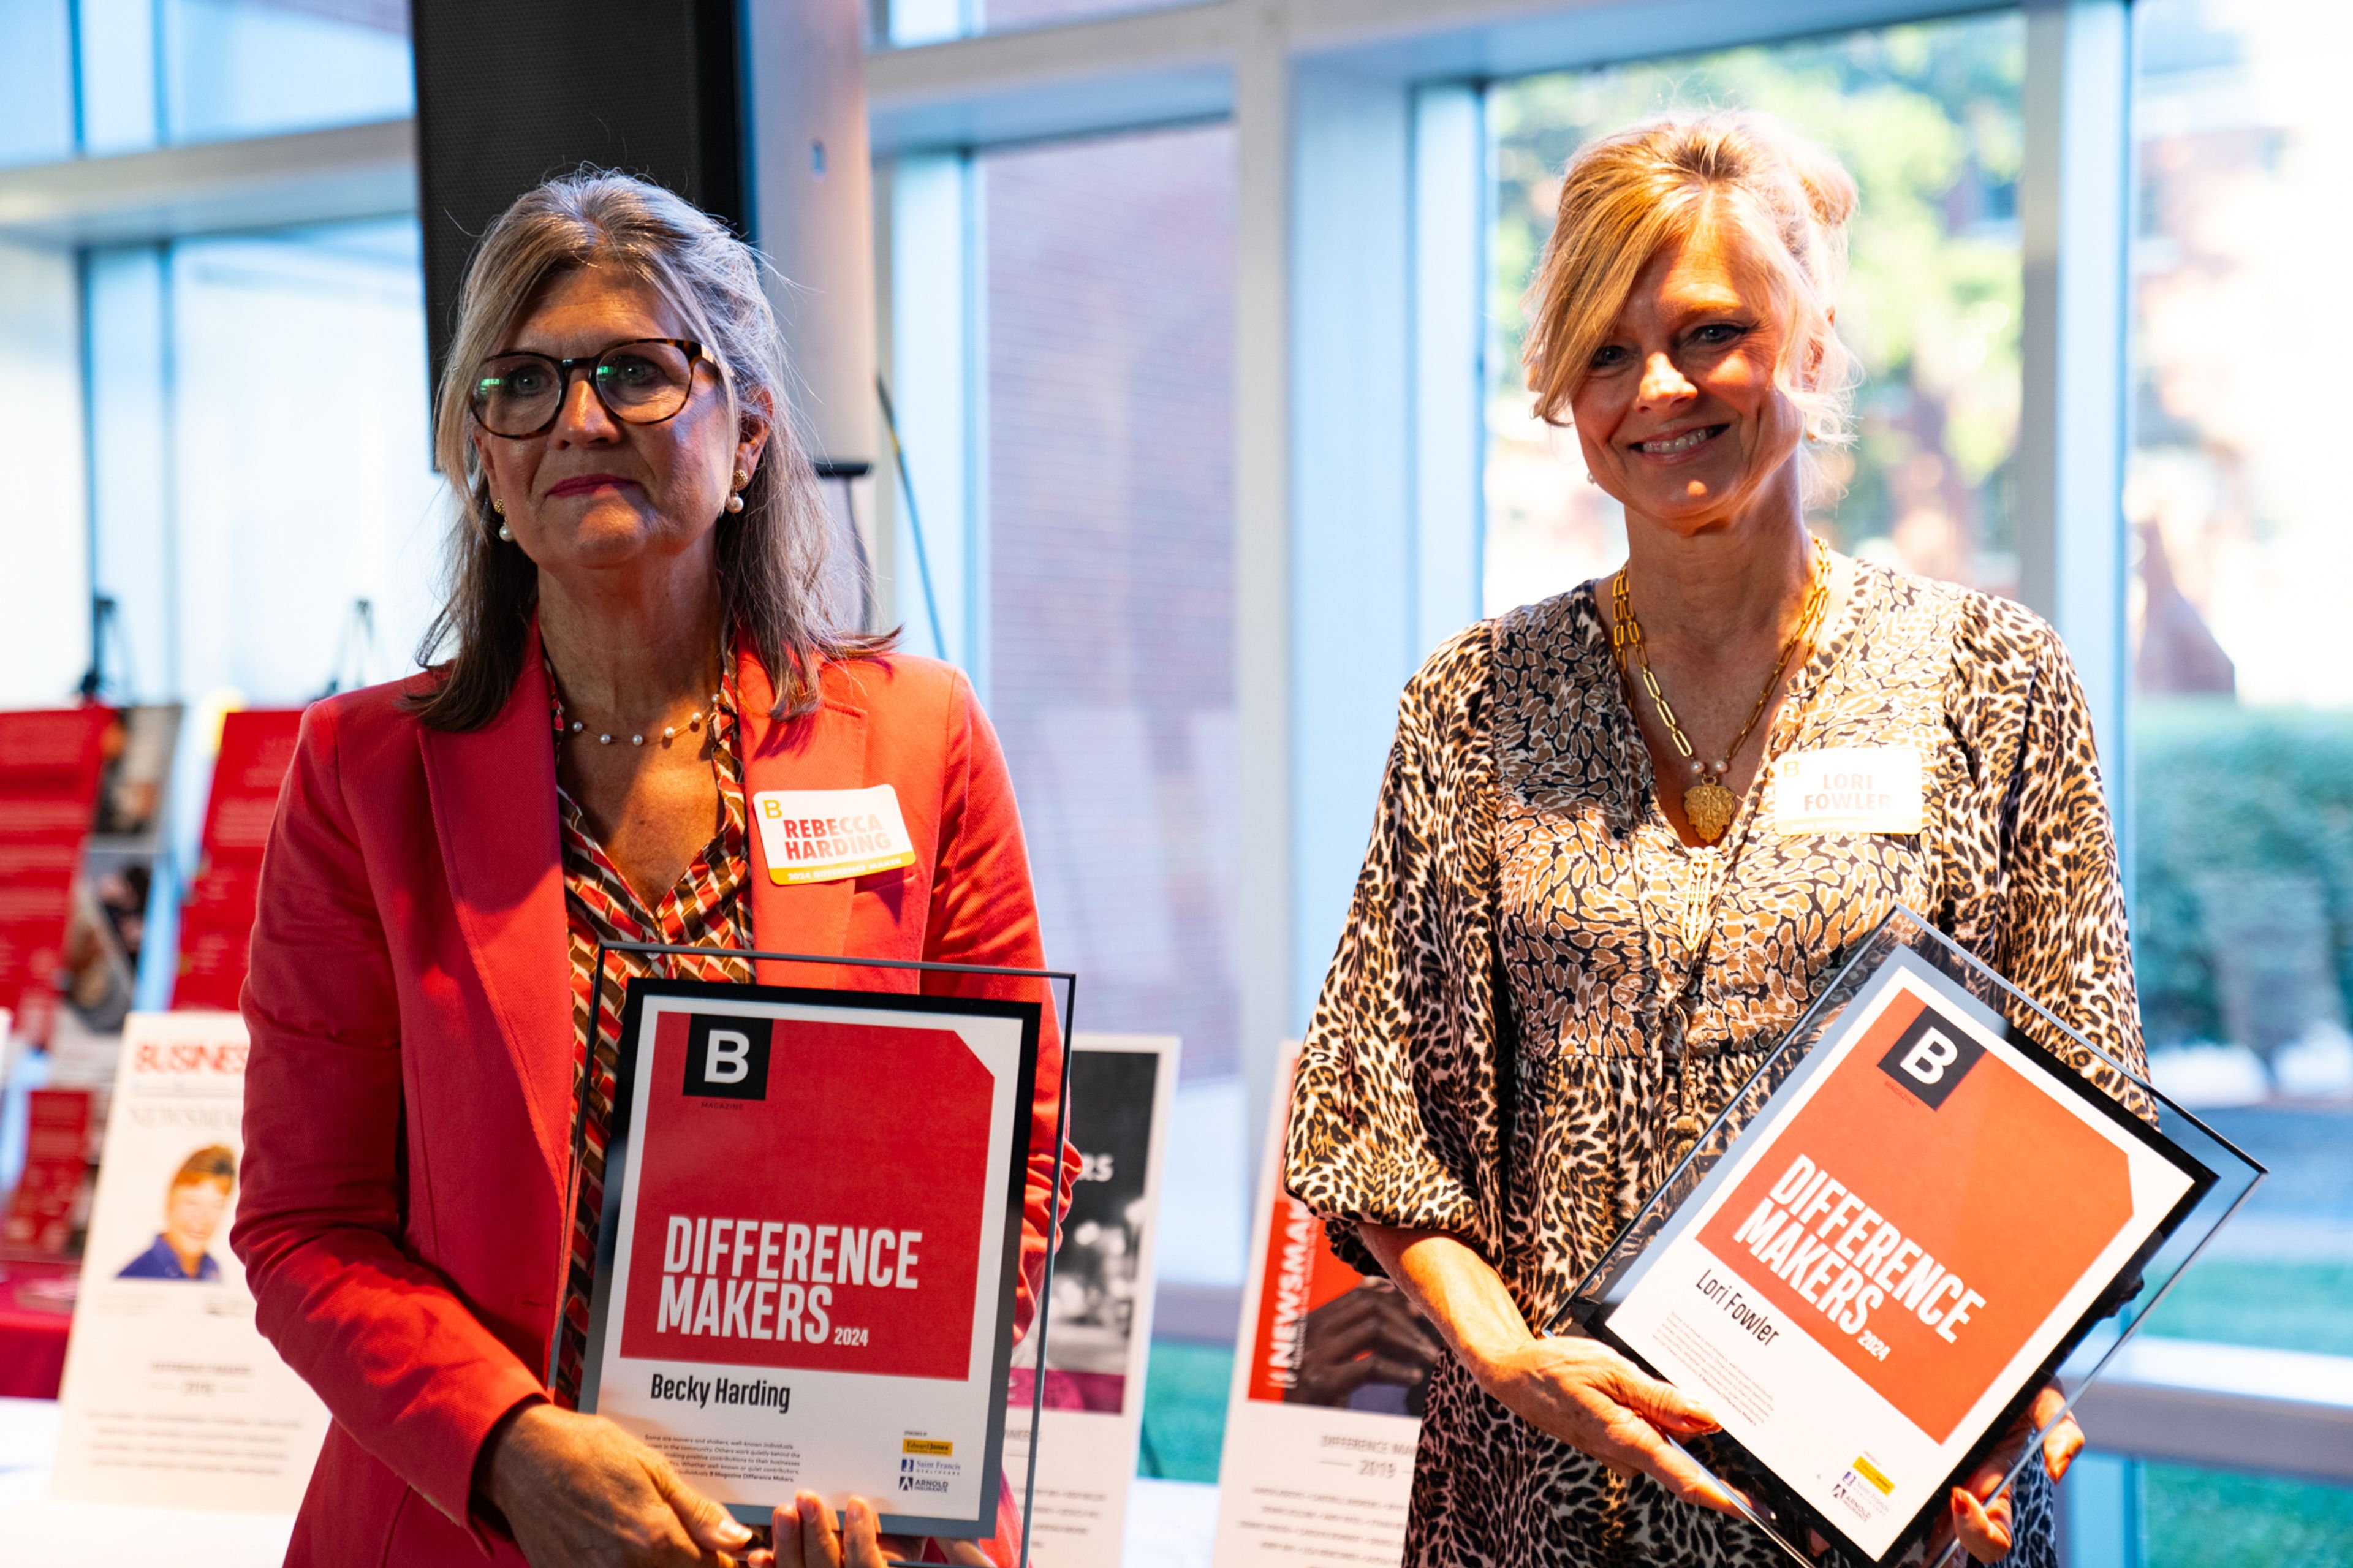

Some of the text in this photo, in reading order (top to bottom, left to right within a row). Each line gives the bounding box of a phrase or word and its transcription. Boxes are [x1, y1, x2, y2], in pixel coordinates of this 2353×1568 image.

[1784, 761, 1799, 778] B
[1823, 773, 1872, 790] LORI
[763, 799, 782, 819] B
[1804, 793, 1892, 811] FOWLER
[783, 813, 883, 839] REBECCA
[784, 832, 891, 860] HARDING
[704, 1029, 751, 1083] B
[1899, 1026, 1958, 1085] B
[701, 1102, 743, 1111] MAGAZINE
[664, 1216, 922, 1289] DIFFERENCE
[1768, 1153, 1987, 1344] DIFFERENCE
[1733, 1197, 1892, 1362] MAKERS 2024
[657, 1275, 869, 1347] MAKERS 2024
[1696, 1268, 1779, 1346] Lori Fowler
[650, 1373, 790, 1414] Becky Harding
[1320, 1435, 1389, 1455] DIFFERENCE
[936, 1462, 961, 1471] Francis
